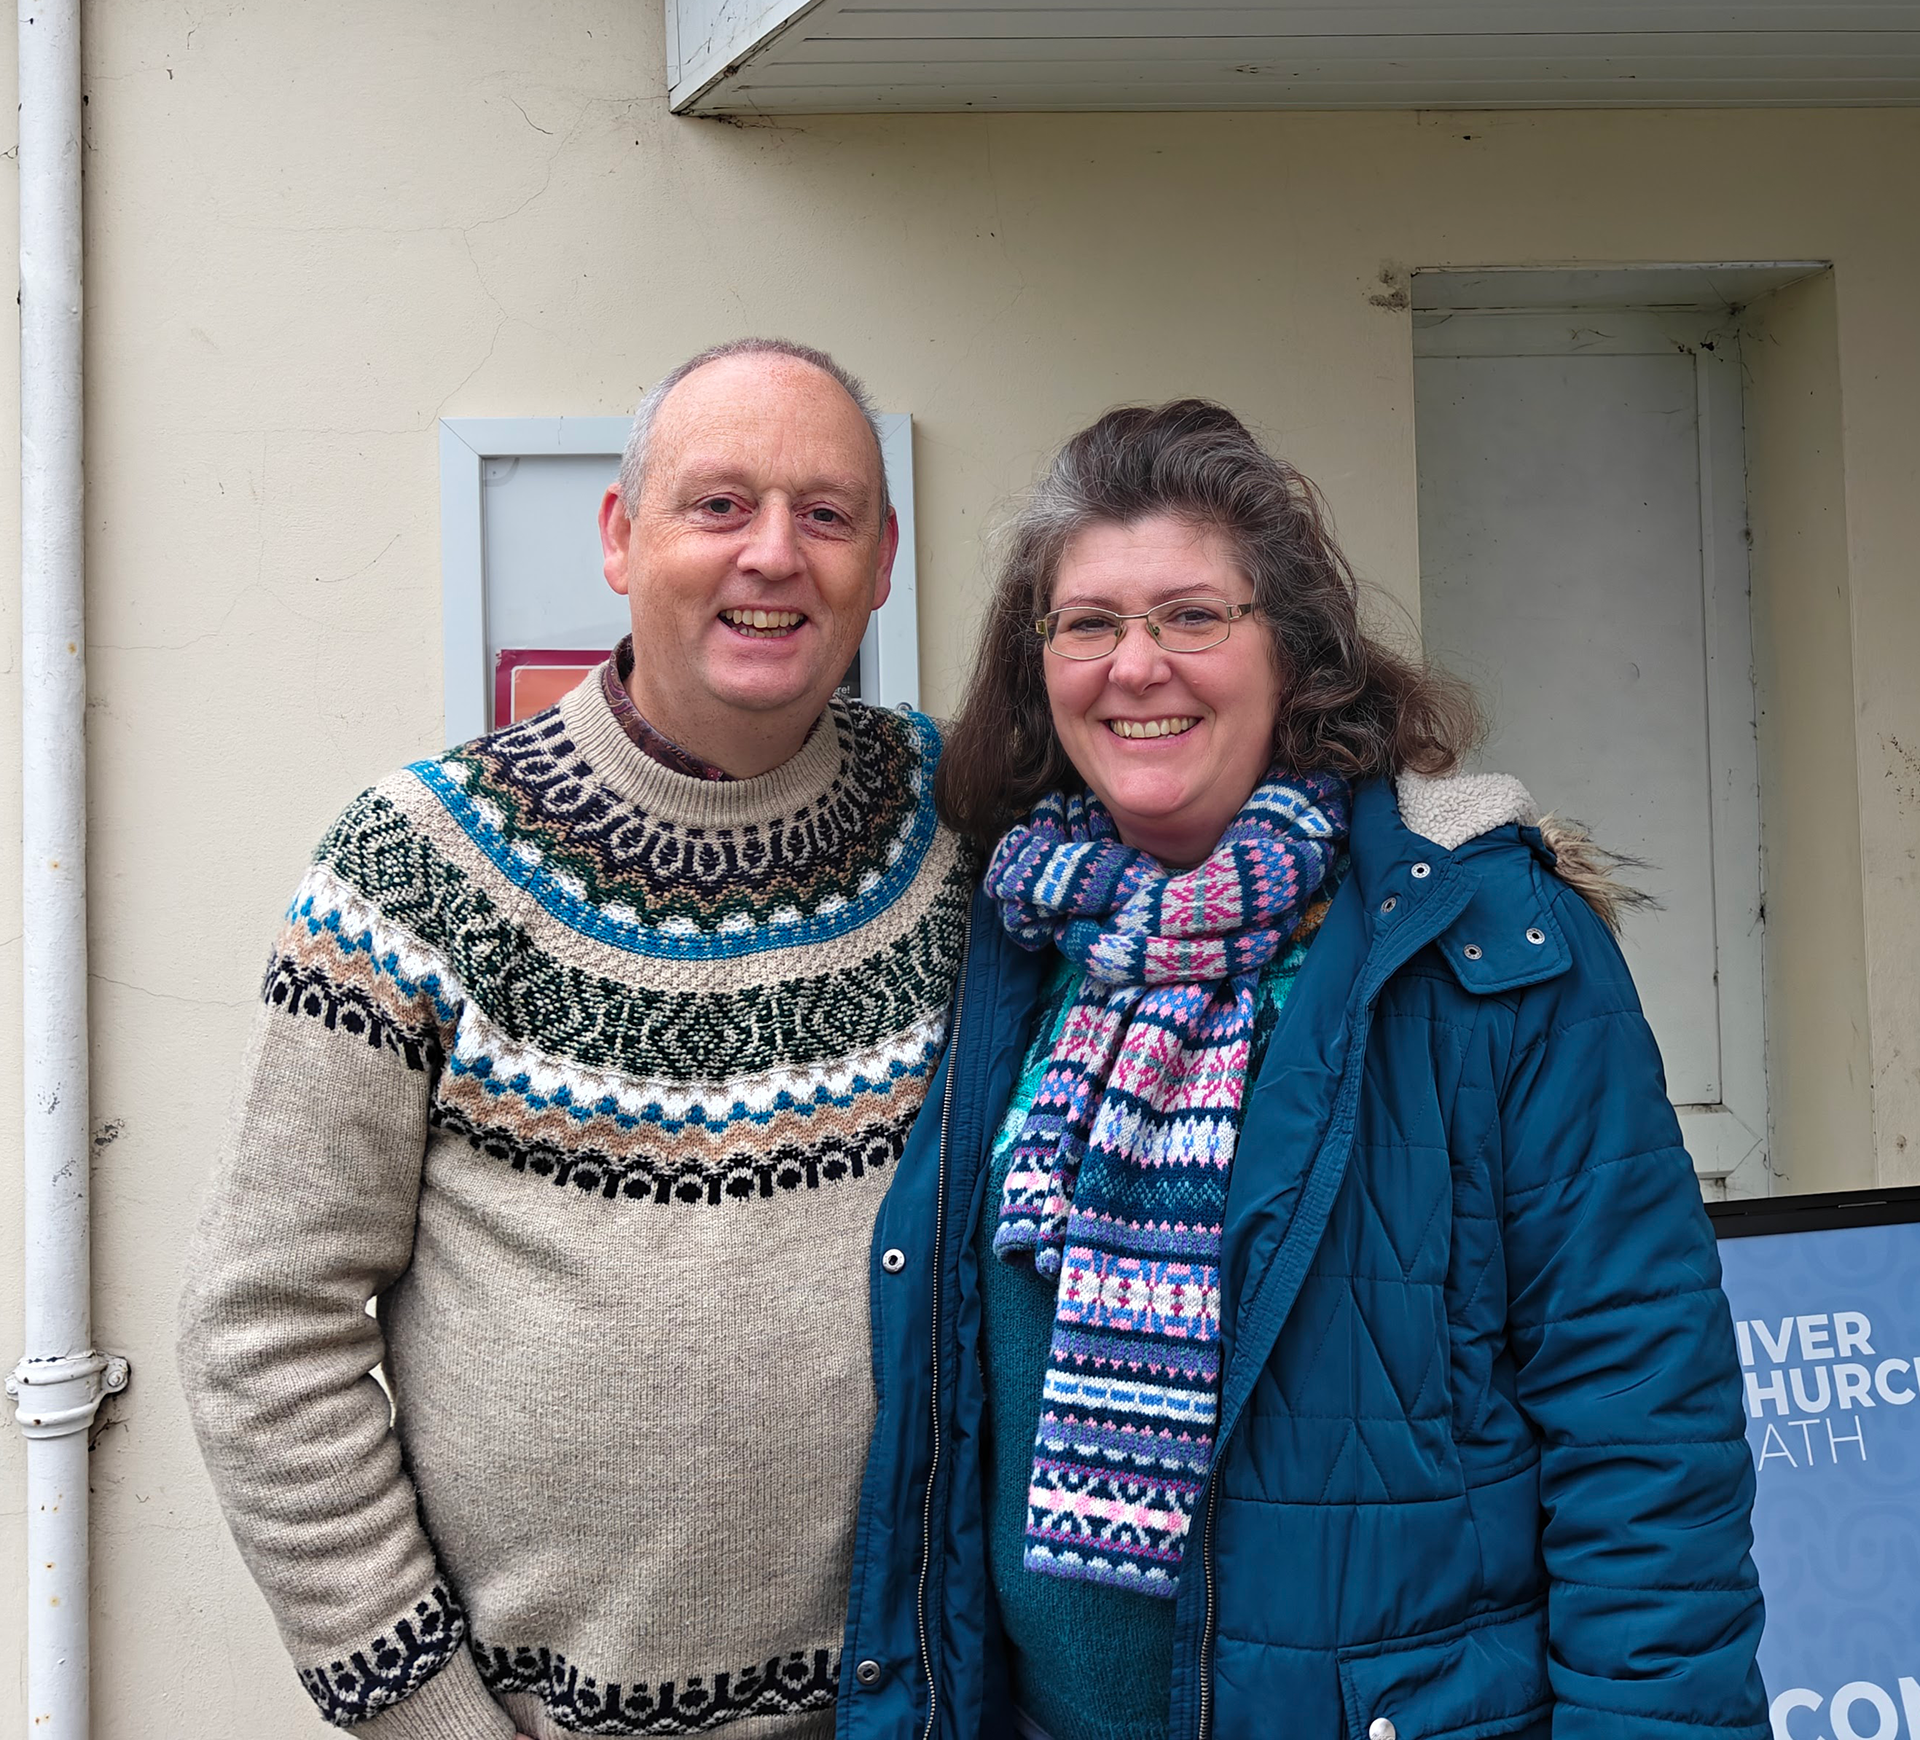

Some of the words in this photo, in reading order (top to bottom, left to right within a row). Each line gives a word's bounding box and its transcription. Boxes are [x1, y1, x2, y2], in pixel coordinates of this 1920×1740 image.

[1736, 1311, 1876, 1366] IVER
[1744, 1357, 1920, 1418] HURC
[1758, 1415, 1867, 1472] ATH
